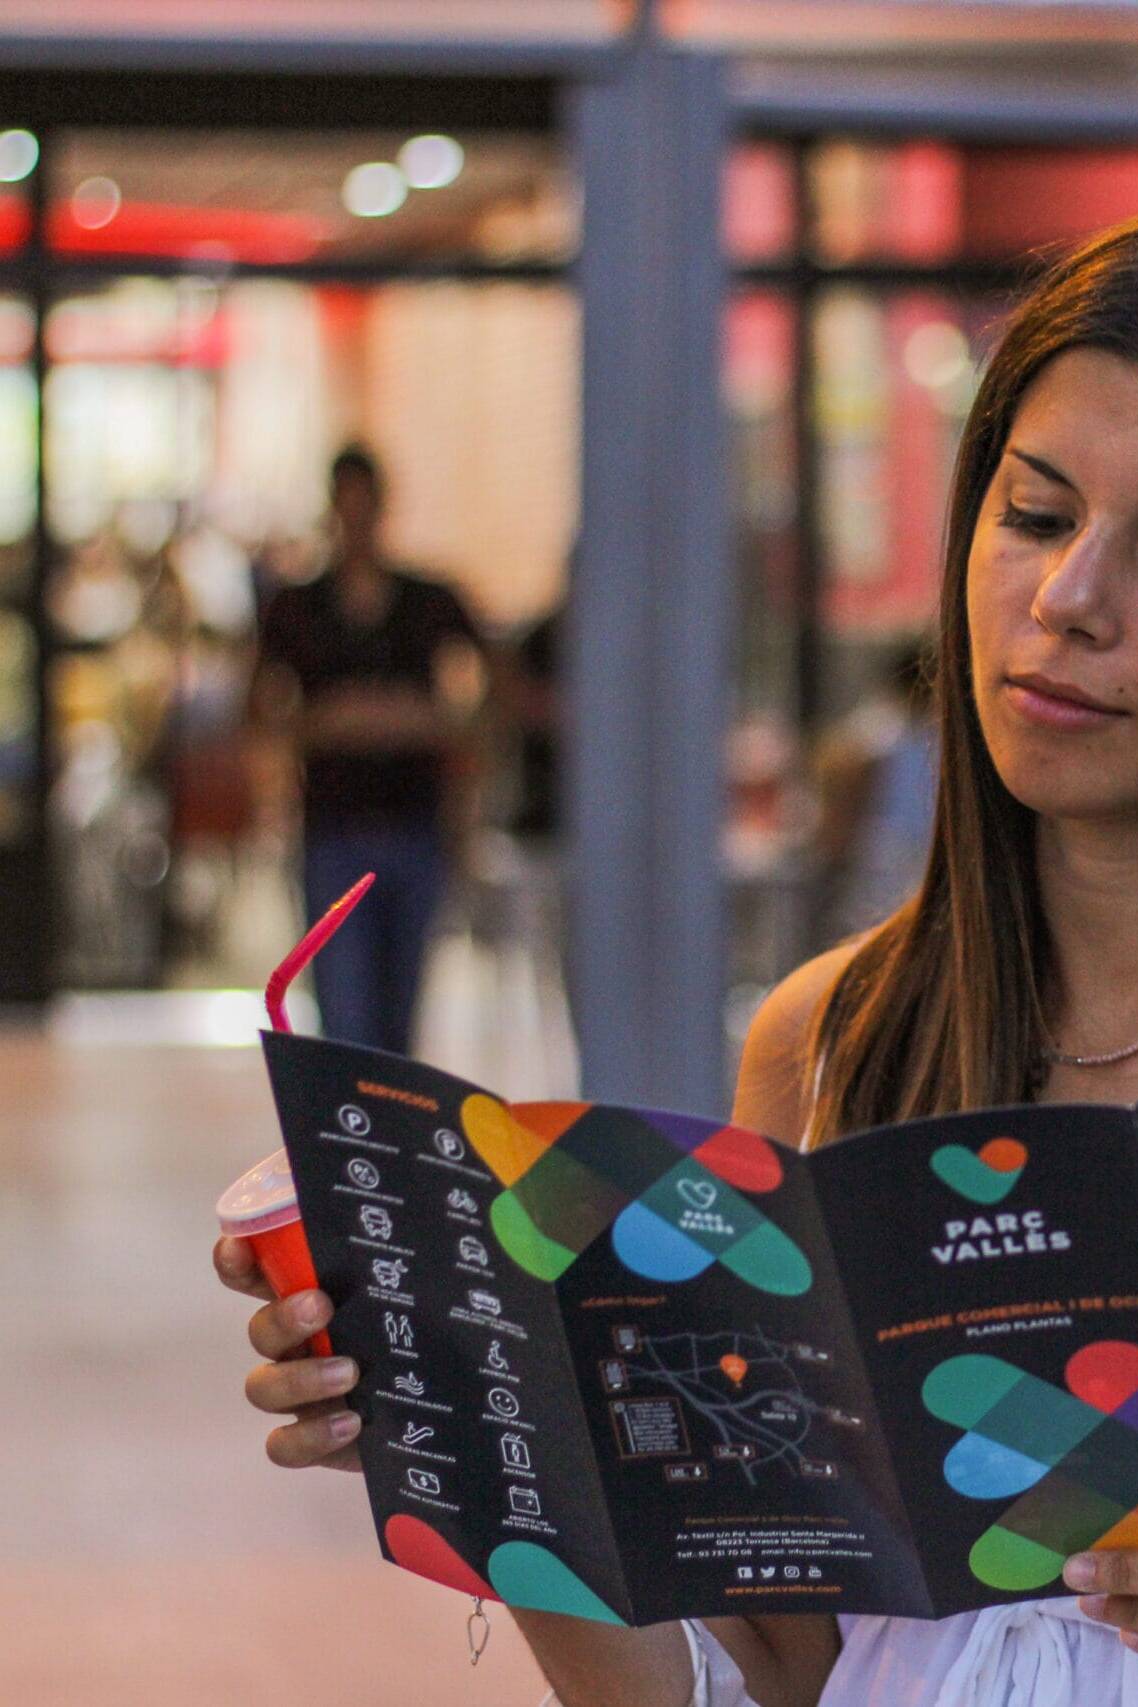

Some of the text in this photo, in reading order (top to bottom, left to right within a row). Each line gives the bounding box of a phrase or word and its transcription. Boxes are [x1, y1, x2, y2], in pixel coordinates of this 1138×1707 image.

[683, 1210, 723, 1221] PARC
[945, 1211, 1044, 1240] PARC
[931, 1229, 1072, 1264] VALLÈS
[877, 1314, 952, 1342] PARQUE
[956, 1300, 1065, 1325] COMERCIAL
[1079, 1297, 1104, 1310] DE
[966, 1315, 1072, 1337] PLANO PLANTAS
